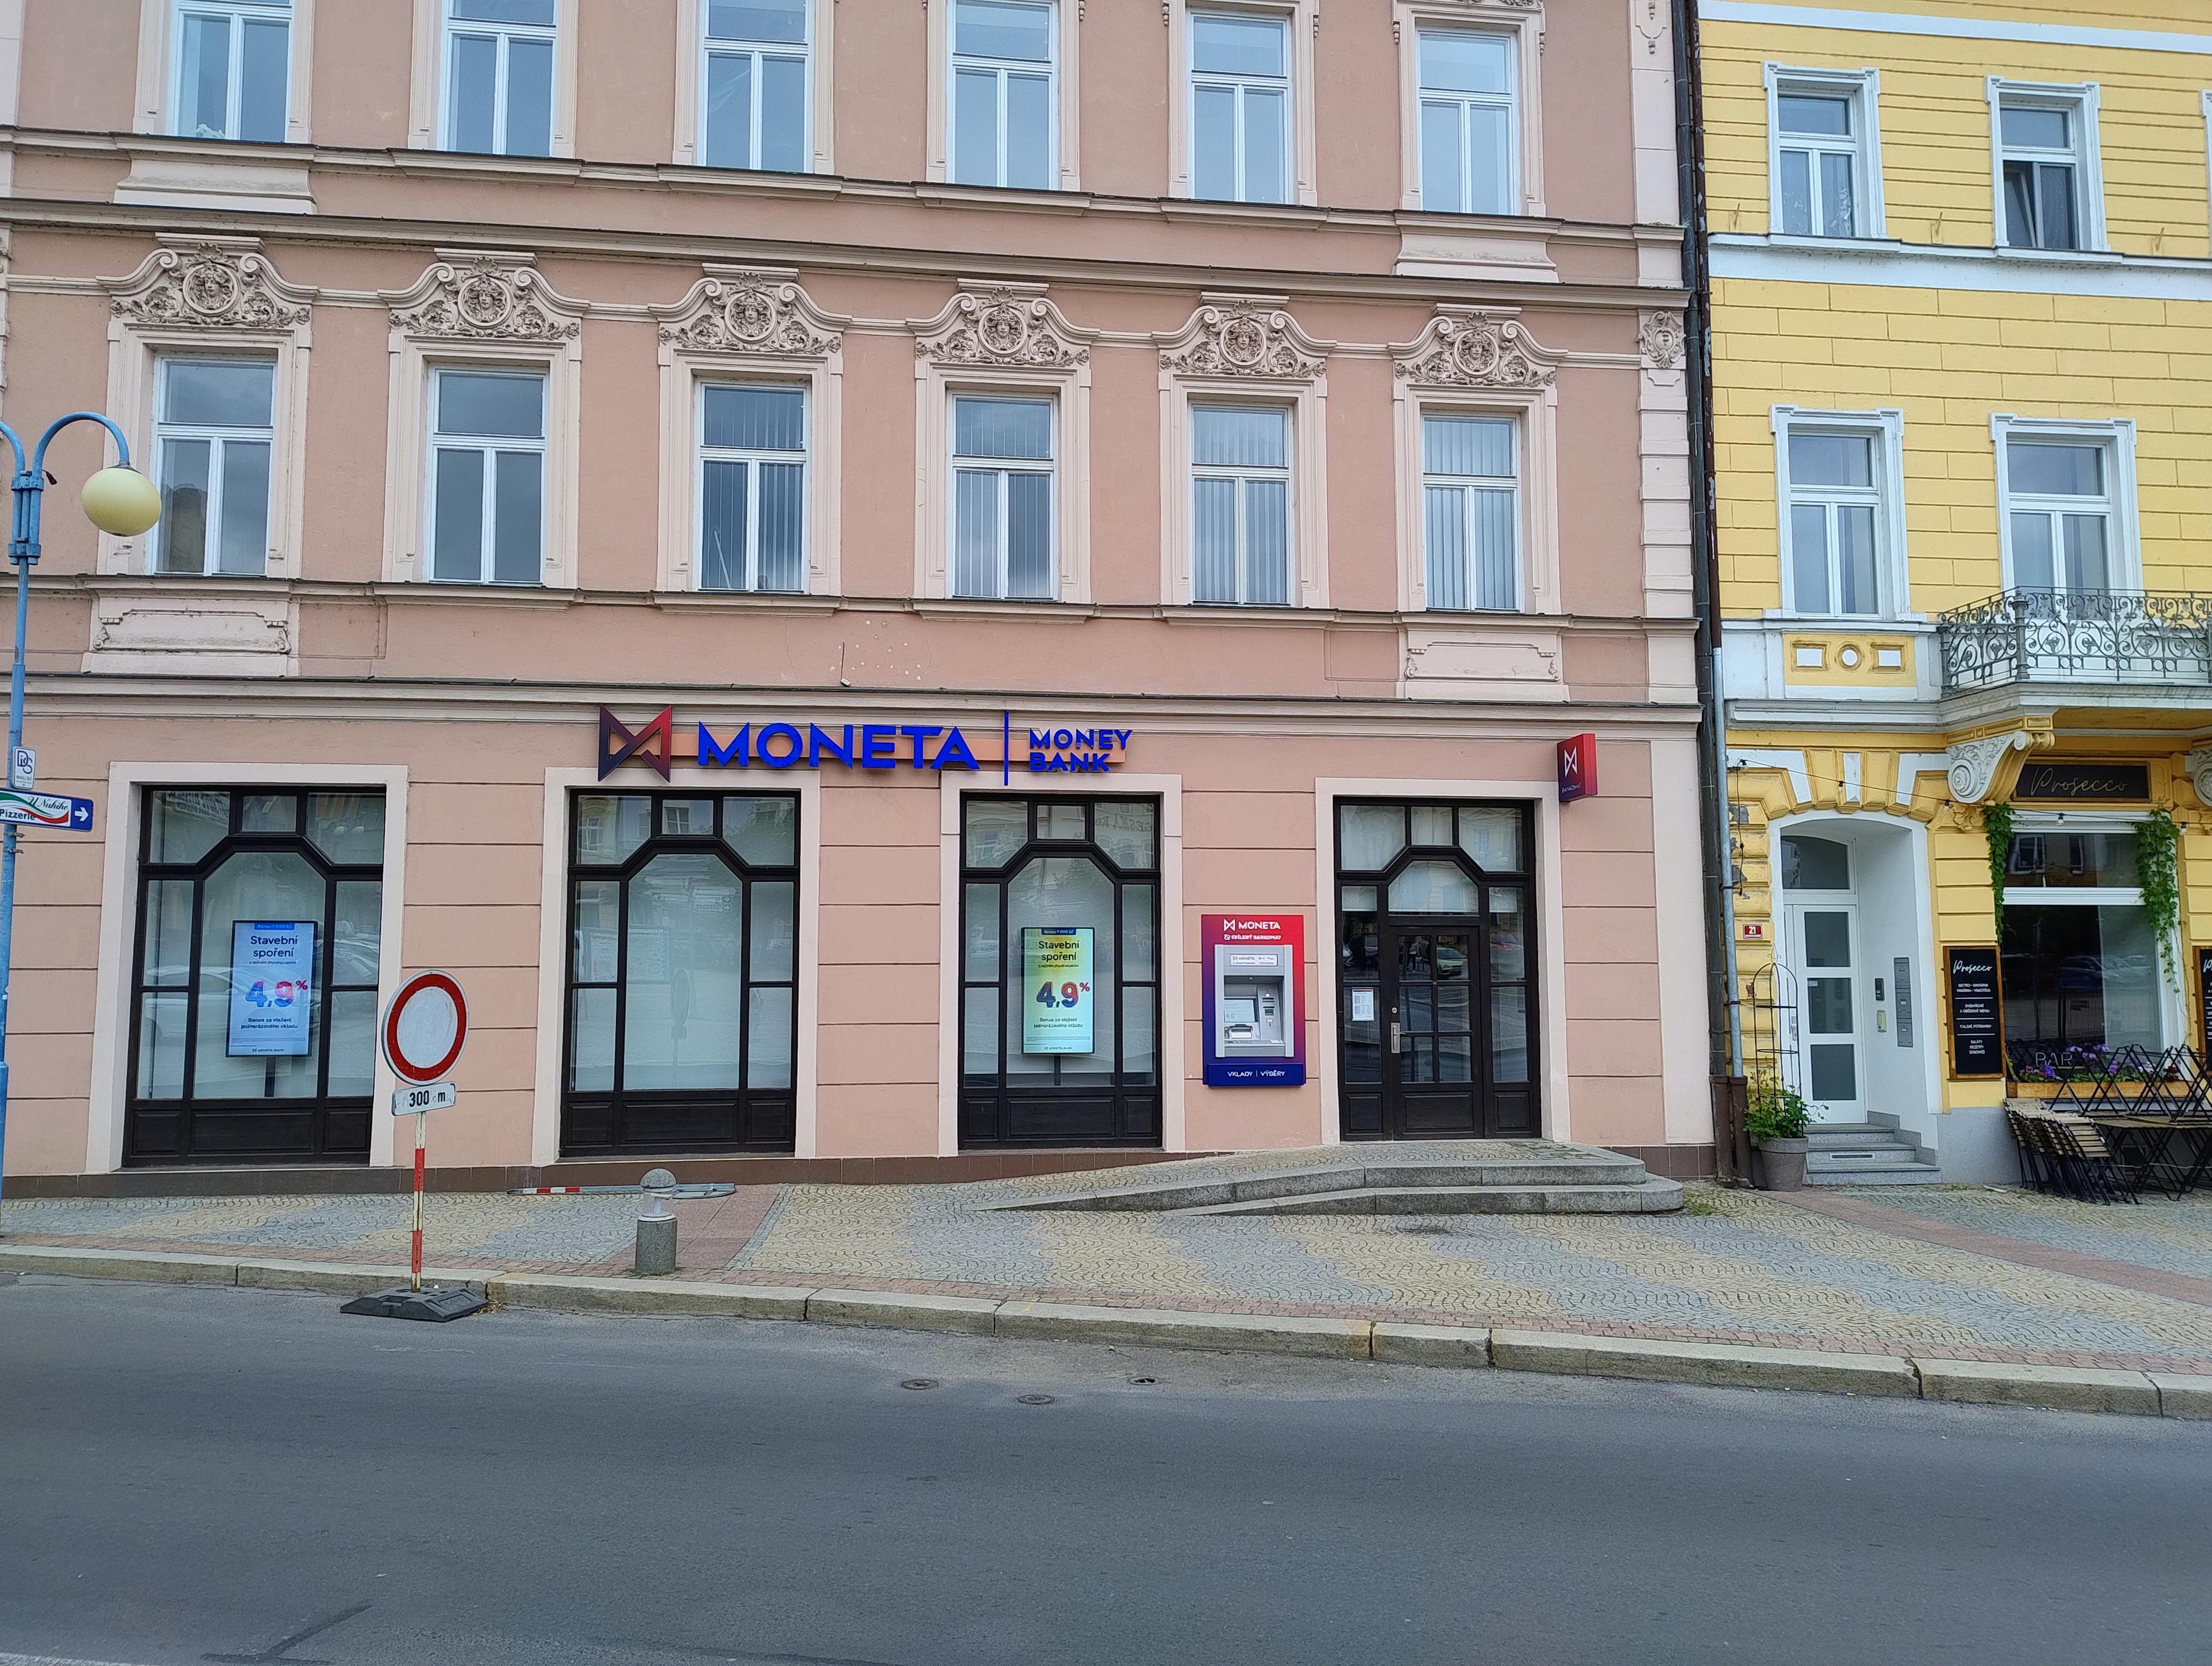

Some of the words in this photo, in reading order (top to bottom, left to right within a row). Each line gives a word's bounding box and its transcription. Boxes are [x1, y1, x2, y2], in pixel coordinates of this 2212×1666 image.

[698, 720, 981, 770] MONETA
[1029, 728, 1133, 750] MONEY
[1029, 751, 1110, 772] BANK
[2030, 767, 2130, 796] Prosecco
[28, 796, 39, 807] U
[0, 809, 36, 820] Pizzerie
[1239, 921, 1281, 930] MONETA
[250, 935, 298, 945] Stavební
[1038, 940, 1079, 949] Stavební
[253, 947, 294, 959] spoření
[1041, 951, 1077, 962] spoření
[1953, 960, 1993, 974] Prosecco
[2035, 1052, 2073, 1066] BAR
[409, 1090, 430, 1107] 300
